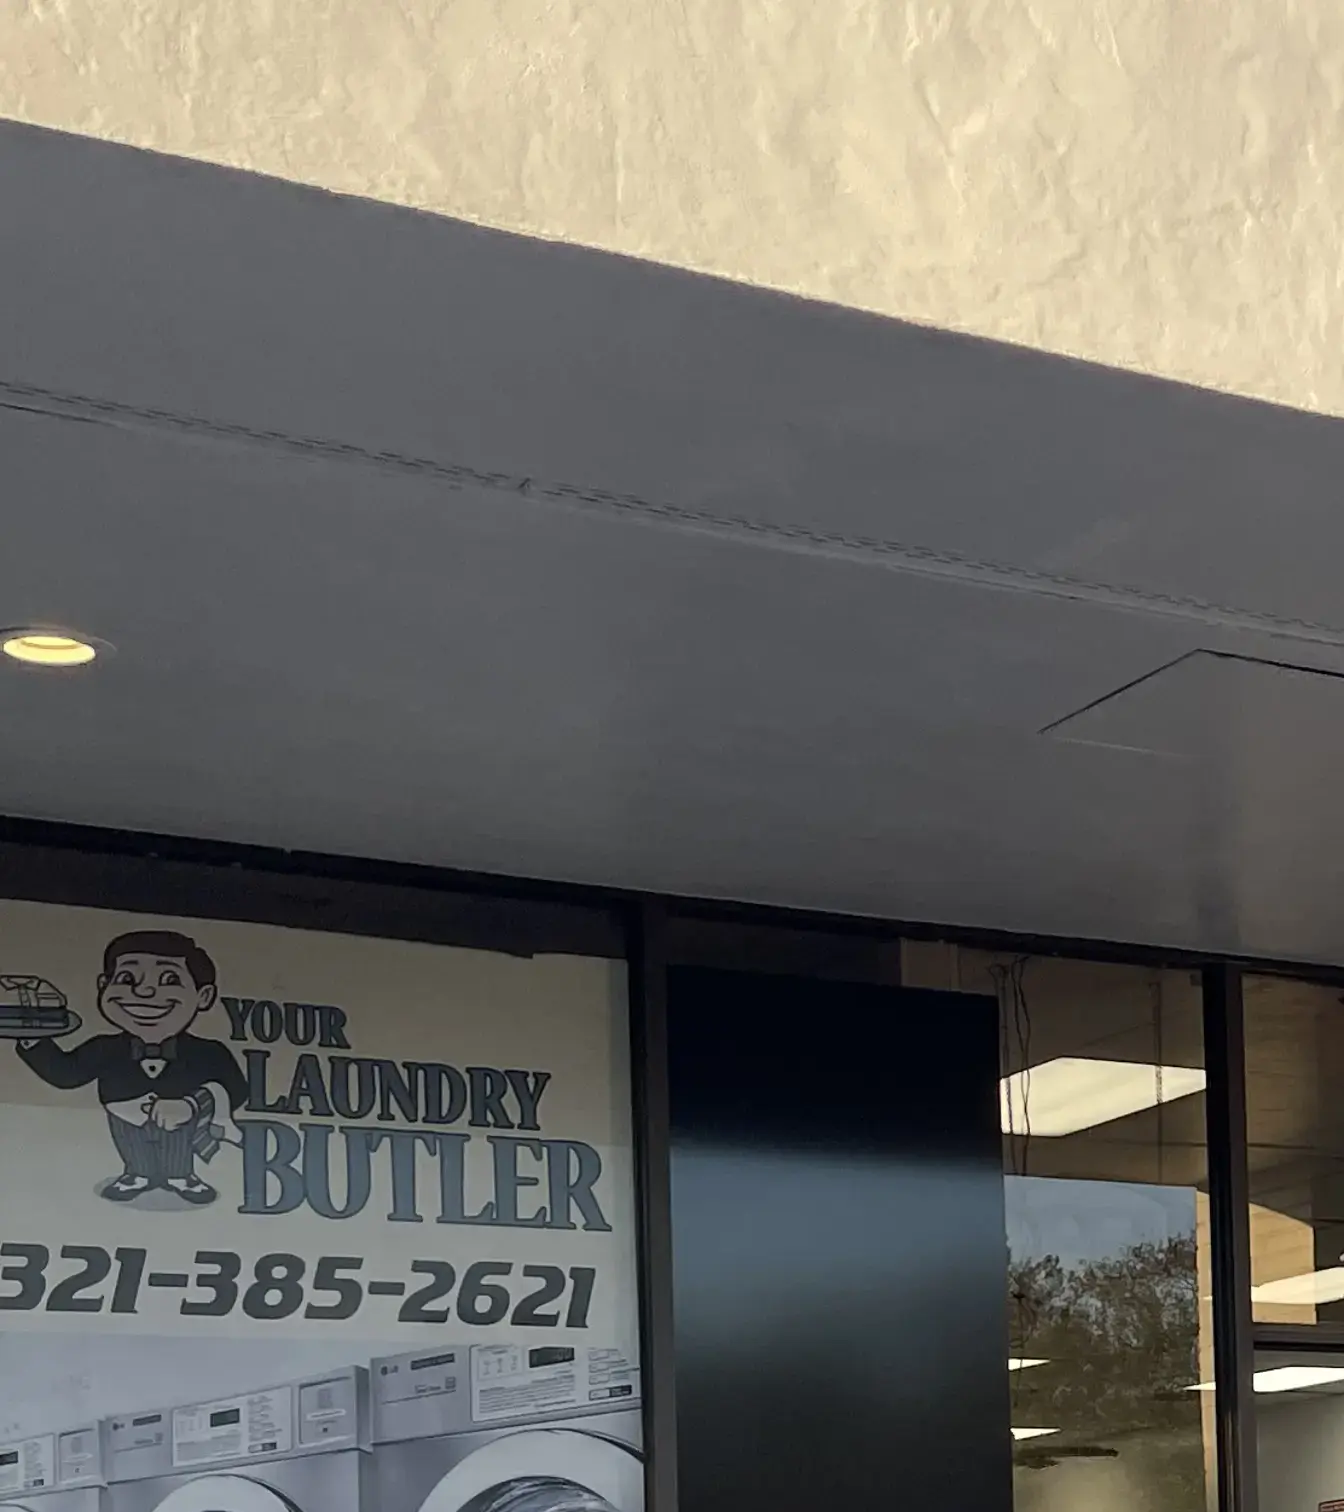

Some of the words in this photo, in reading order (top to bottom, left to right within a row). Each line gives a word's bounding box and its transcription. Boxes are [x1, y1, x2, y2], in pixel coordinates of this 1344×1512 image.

[219, 996, 351, 1049] YOUR
[243, 1049, 552, 1131] LAUNDRY
[237, 1118, 612, 1232] BUTLER
[0, 1241, 597, 1329] 321-385-2621
